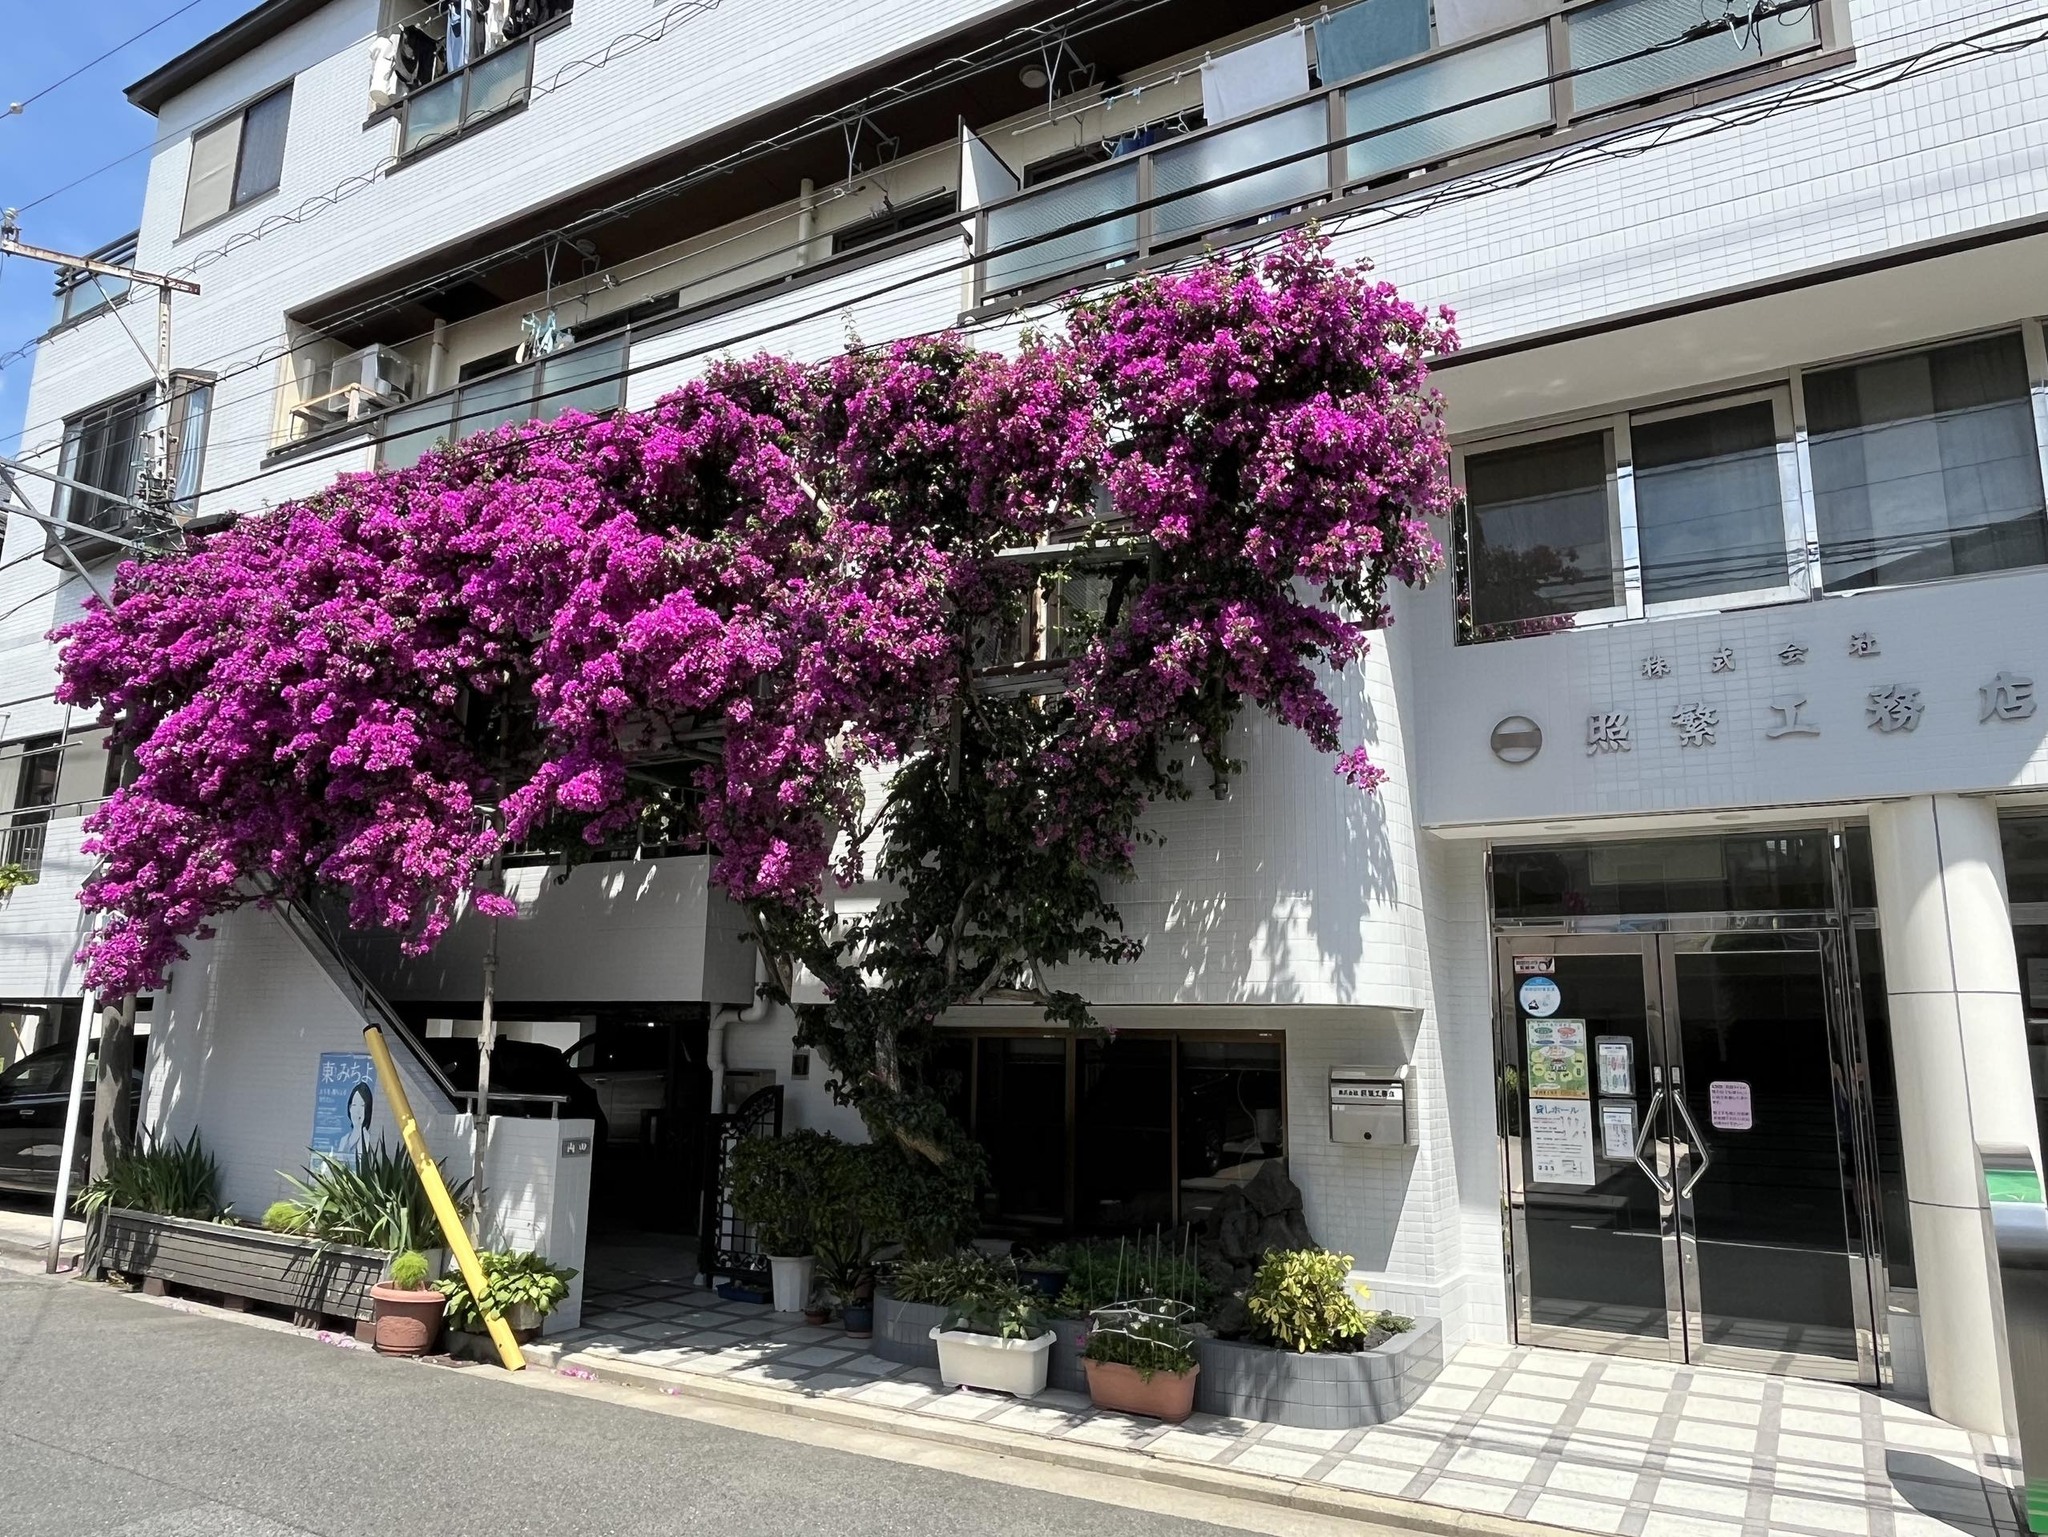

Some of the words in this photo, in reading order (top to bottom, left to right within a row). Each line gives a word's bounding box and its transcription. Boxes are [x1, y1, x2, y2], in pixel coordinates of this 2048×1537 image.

[1641, 632, 1881, 680] 株式会社
[1586, 671, 2037, 756] 照繁工務店
[321, 1061, 374, 1084] 東みちよ
[1535, 1104, 1580, 1114] 貸しホール
